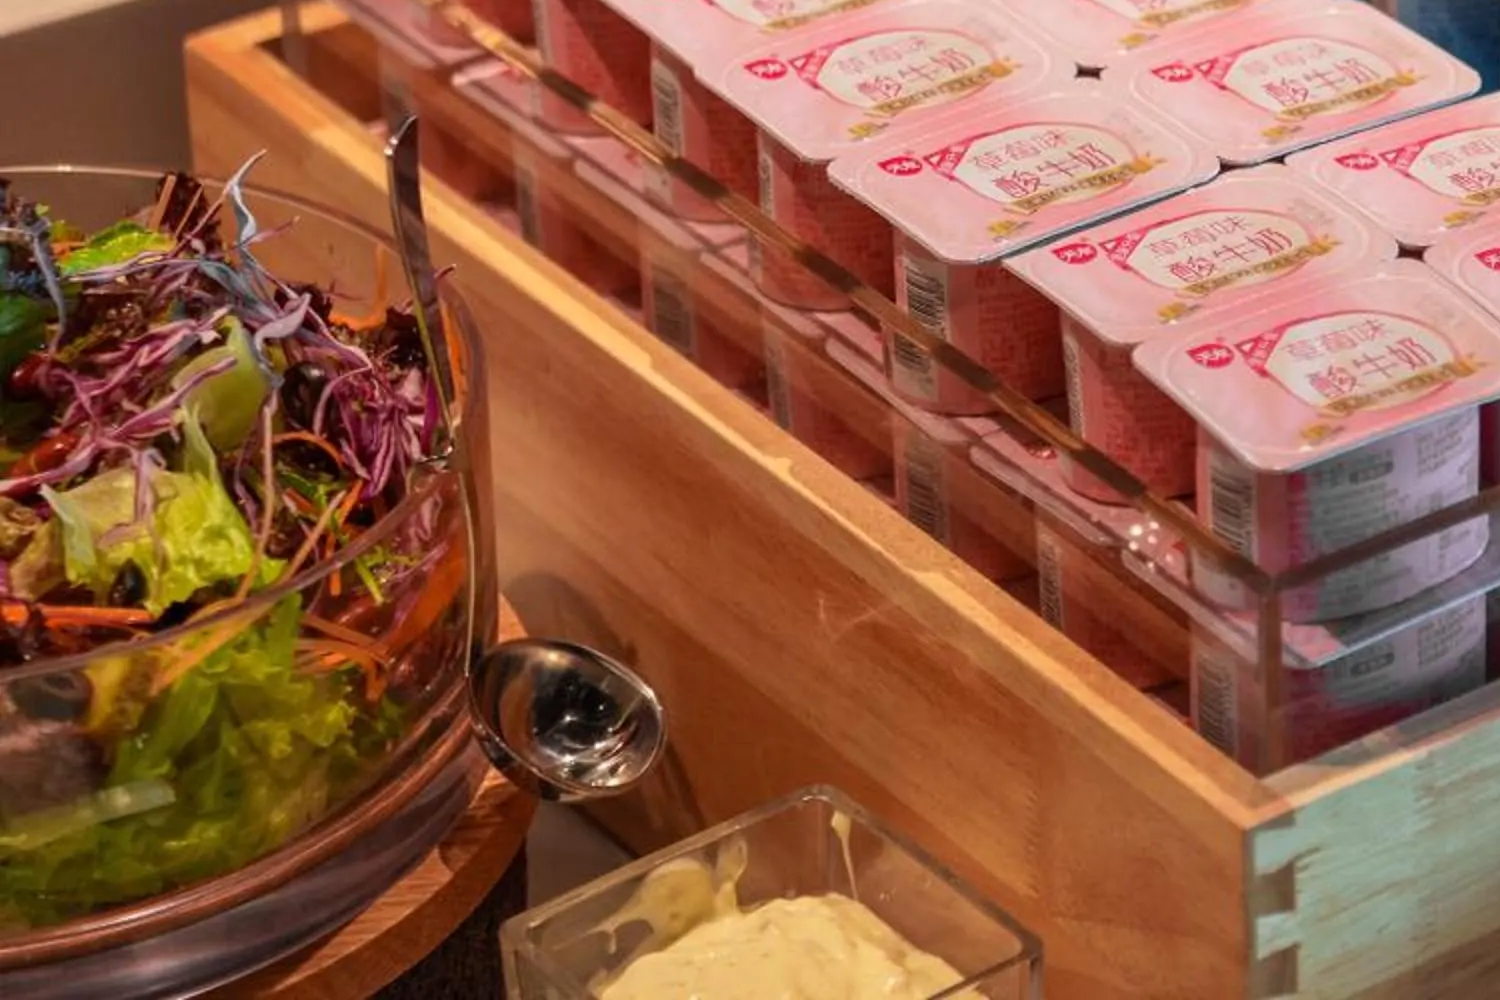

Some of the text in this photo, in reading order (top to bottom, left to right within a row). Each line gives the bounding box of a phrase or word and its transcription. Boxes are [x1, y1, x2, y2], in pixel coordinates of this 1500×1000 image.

[857, 48, 978, 95] 酸牛奶
[1260, 58, 1382, 106] 酸牛奶
[973, 129, 1070, 172] 草莓味
[992, 142, 1117, 198] 酸牛奶
[1148, 216, 1251, 258] 草莓味
[1169, 227, 1294, 283] 酸牛奶
[1285, 318, 1389, 363] 草莓味
[1307, 337, 1438, 397] 酸牛奶
